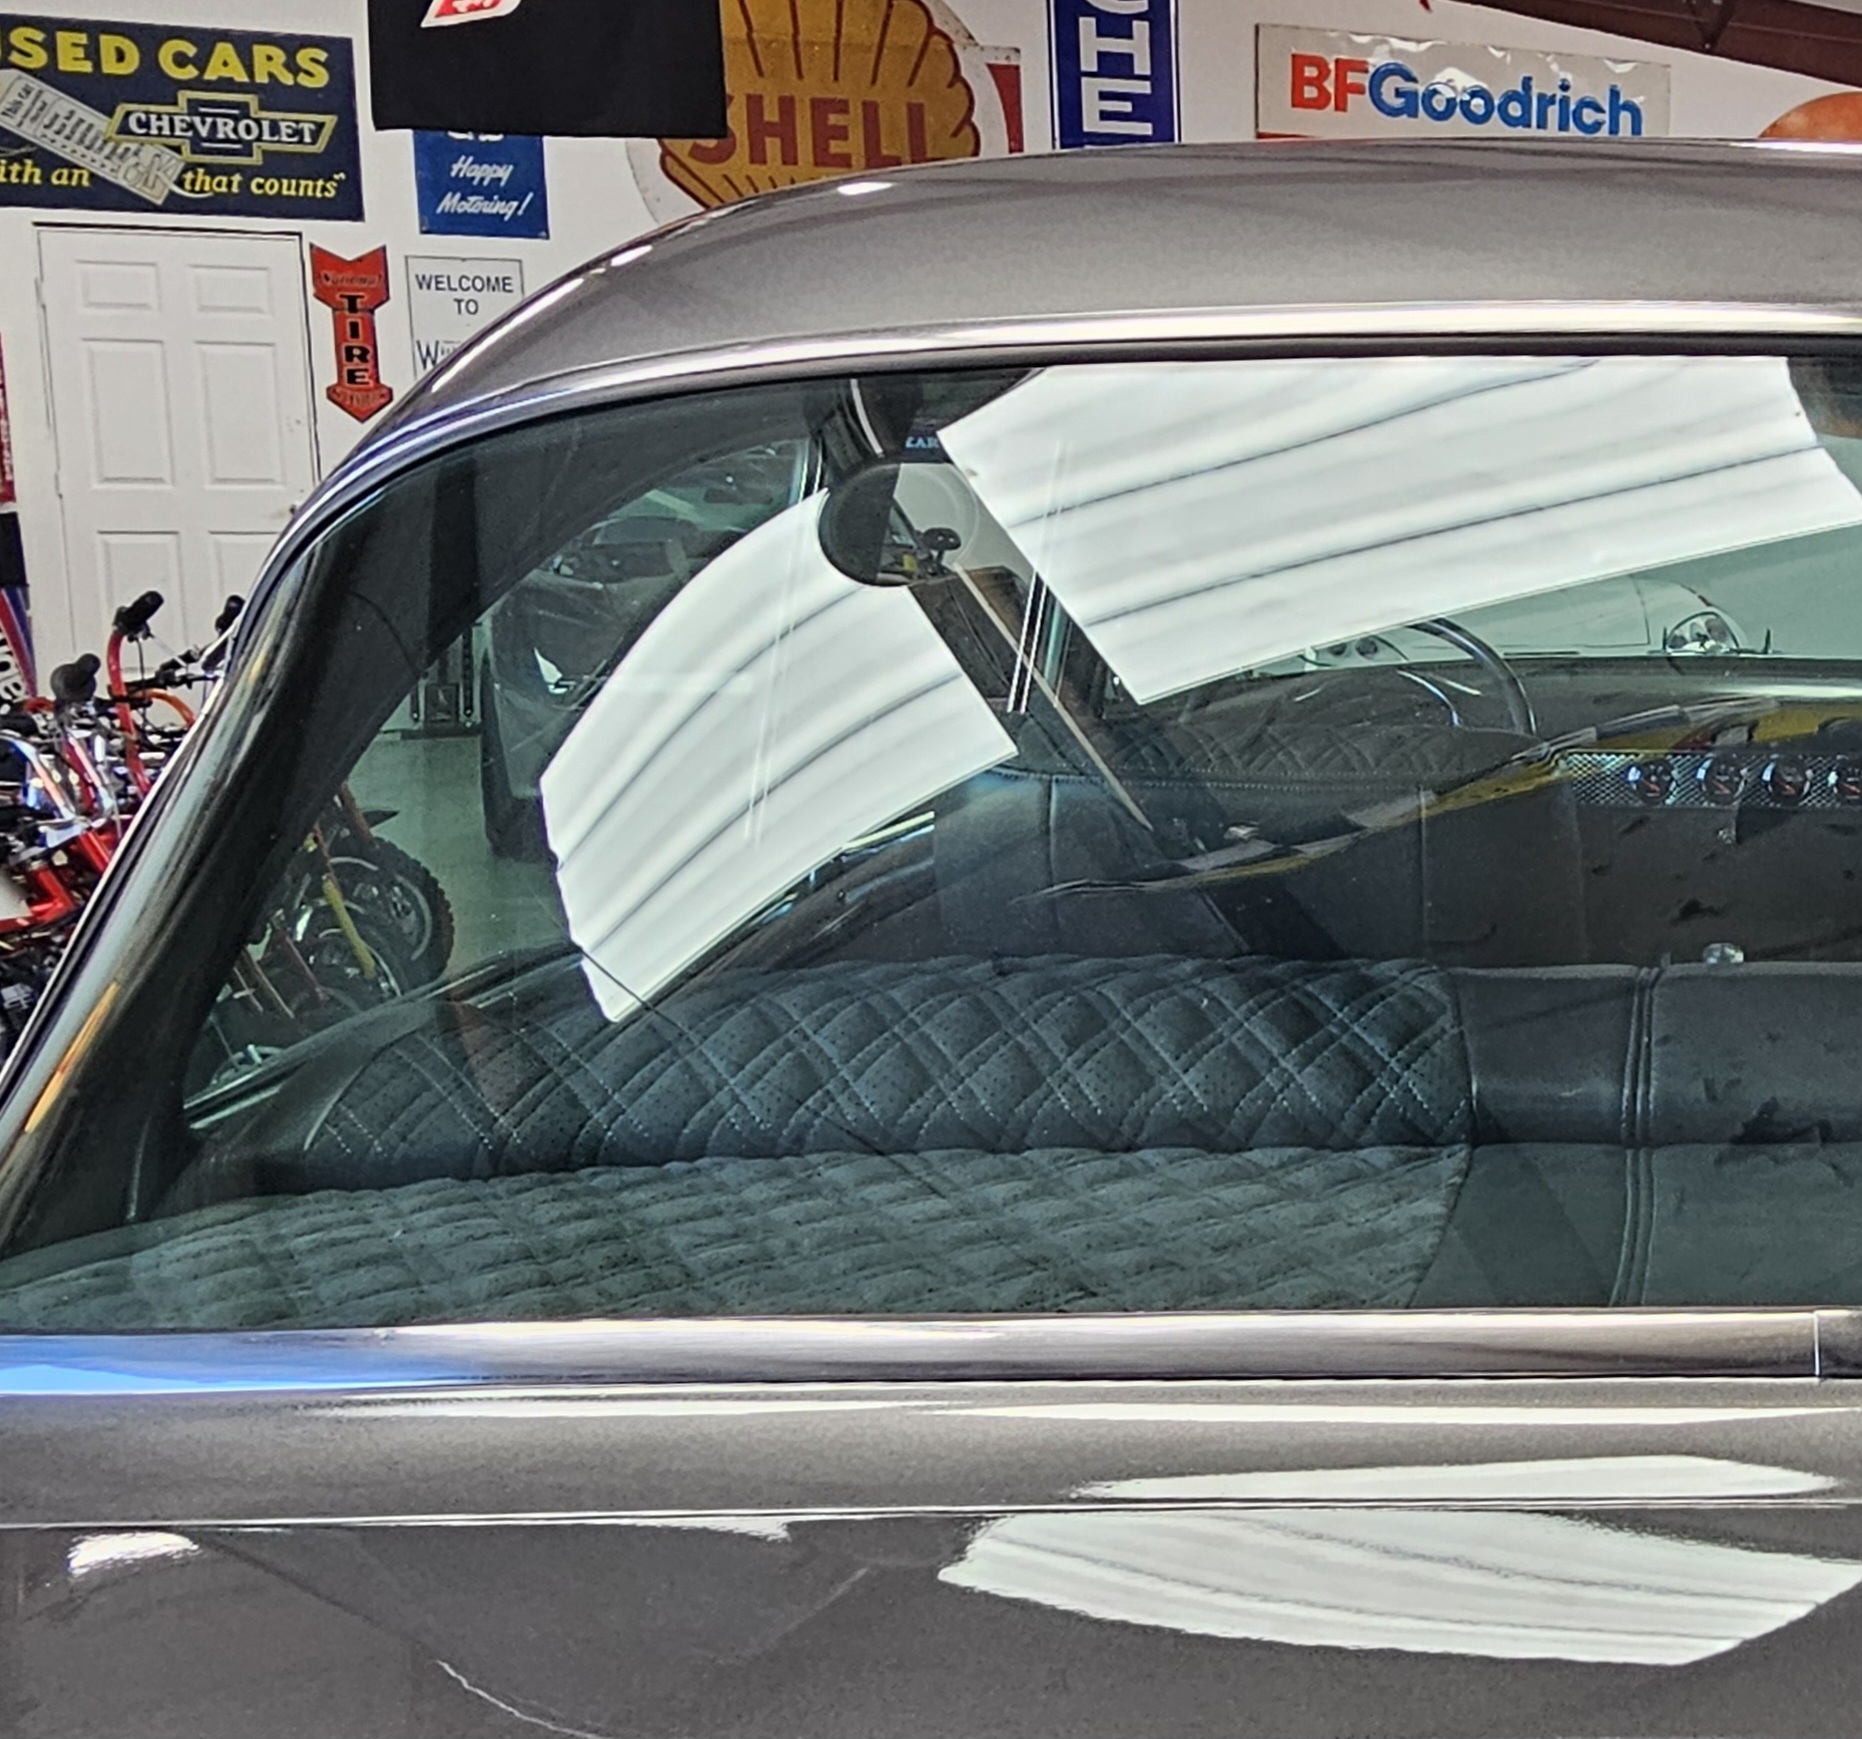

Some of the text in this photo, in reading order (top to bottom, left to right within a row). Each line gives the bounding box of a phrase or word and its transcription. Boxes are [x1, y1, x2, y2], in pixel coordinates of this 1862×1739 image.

[0, 27, 330, 88] SED CARS
[1079, 0, 1153, 135] HE
[1290, 53, 1644, 136] BFGoodrich
[128, 111, 316, 143] CHEVROLET
[0, 159, 42, 185] ith
[51, 168, 91, 187] an
[183, 167, 243, 193] that
[450, 154, 514, 187] Happy
[435, 191, 534, 221] Motoring!
[415, 274, 514, 293] WELCOME
[453, 299, 479, 316] TO
[337, 292, 373, 387] TIRE
